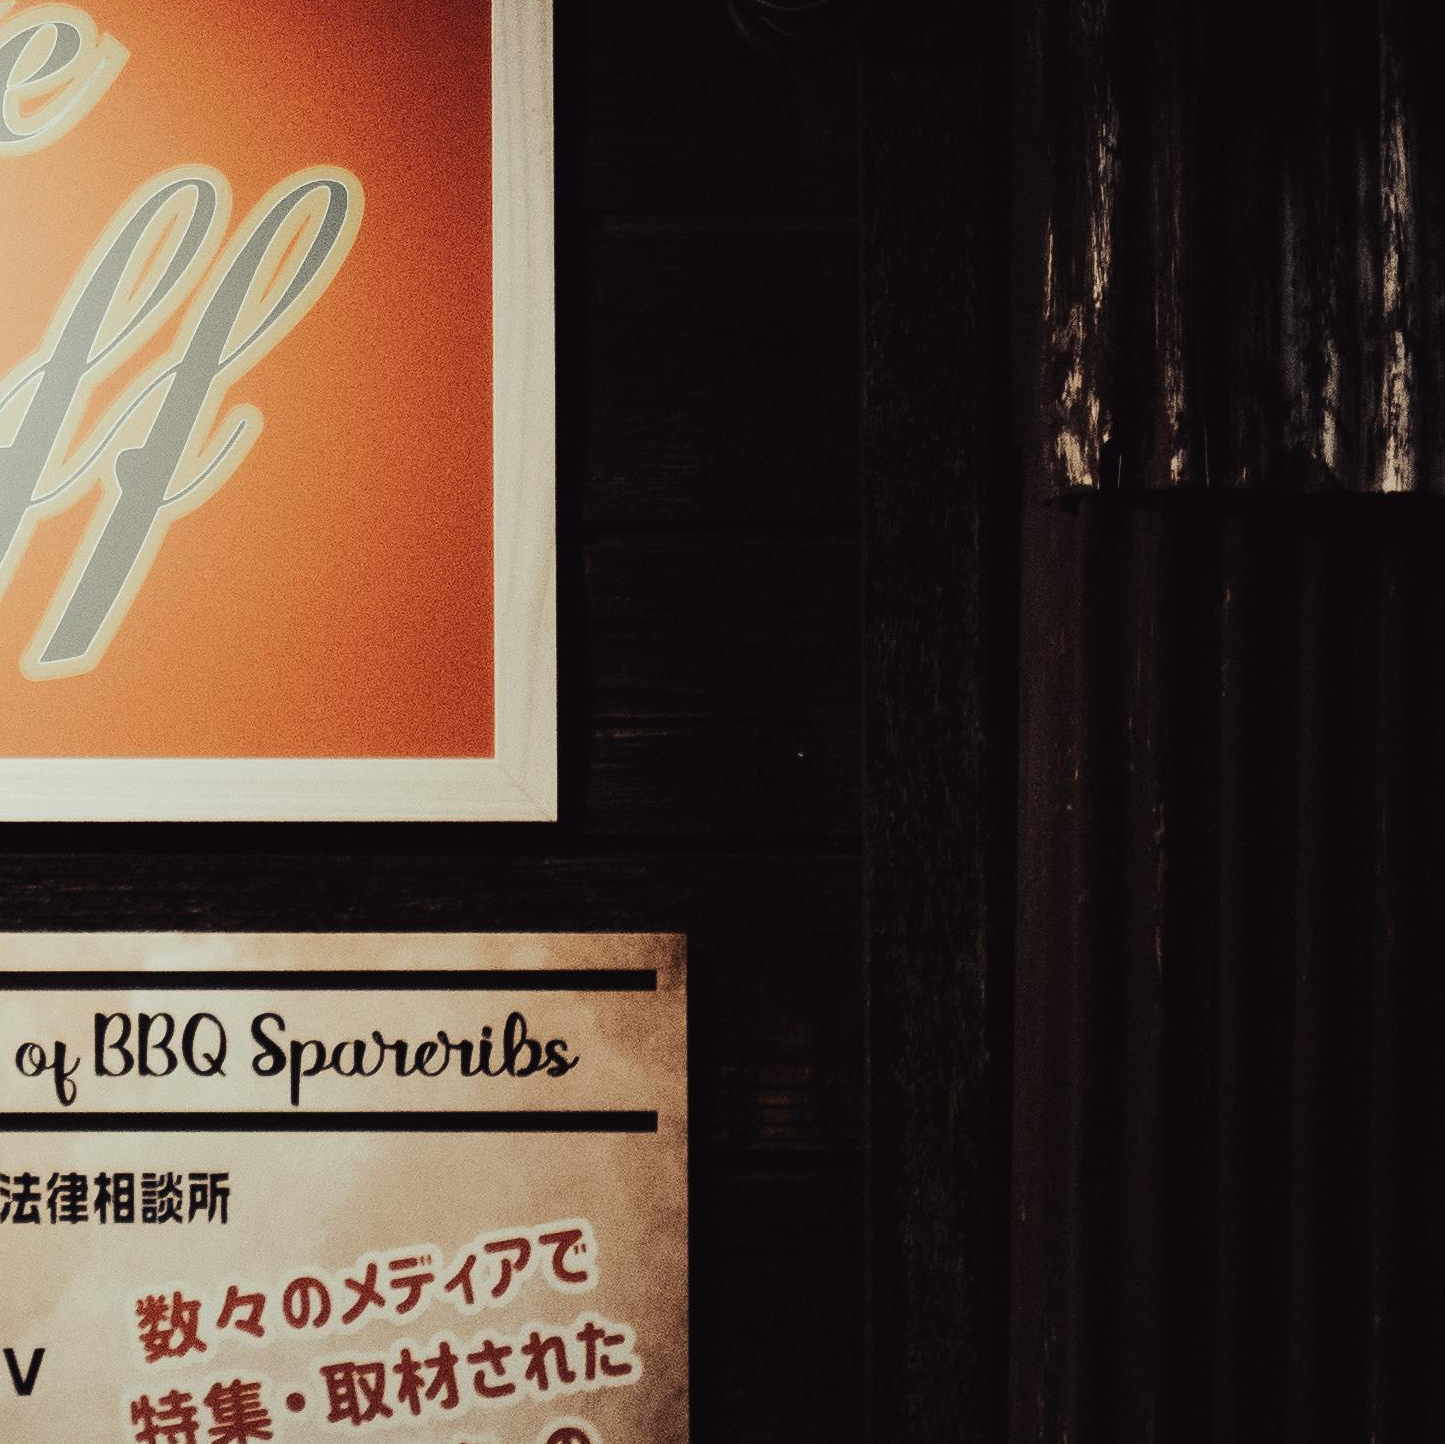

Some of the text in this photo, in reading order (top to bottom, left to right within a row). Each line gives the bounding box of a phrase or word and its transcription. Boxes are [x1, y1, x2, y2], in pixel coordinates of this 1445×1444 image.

[14, 1028, 83, 1107] of
[94, 1011, 228, 1078] BBQ
[249, 1011, 580, 1107] Spareribs
[135, 1226, 591, 1363] 数々のメディアで
